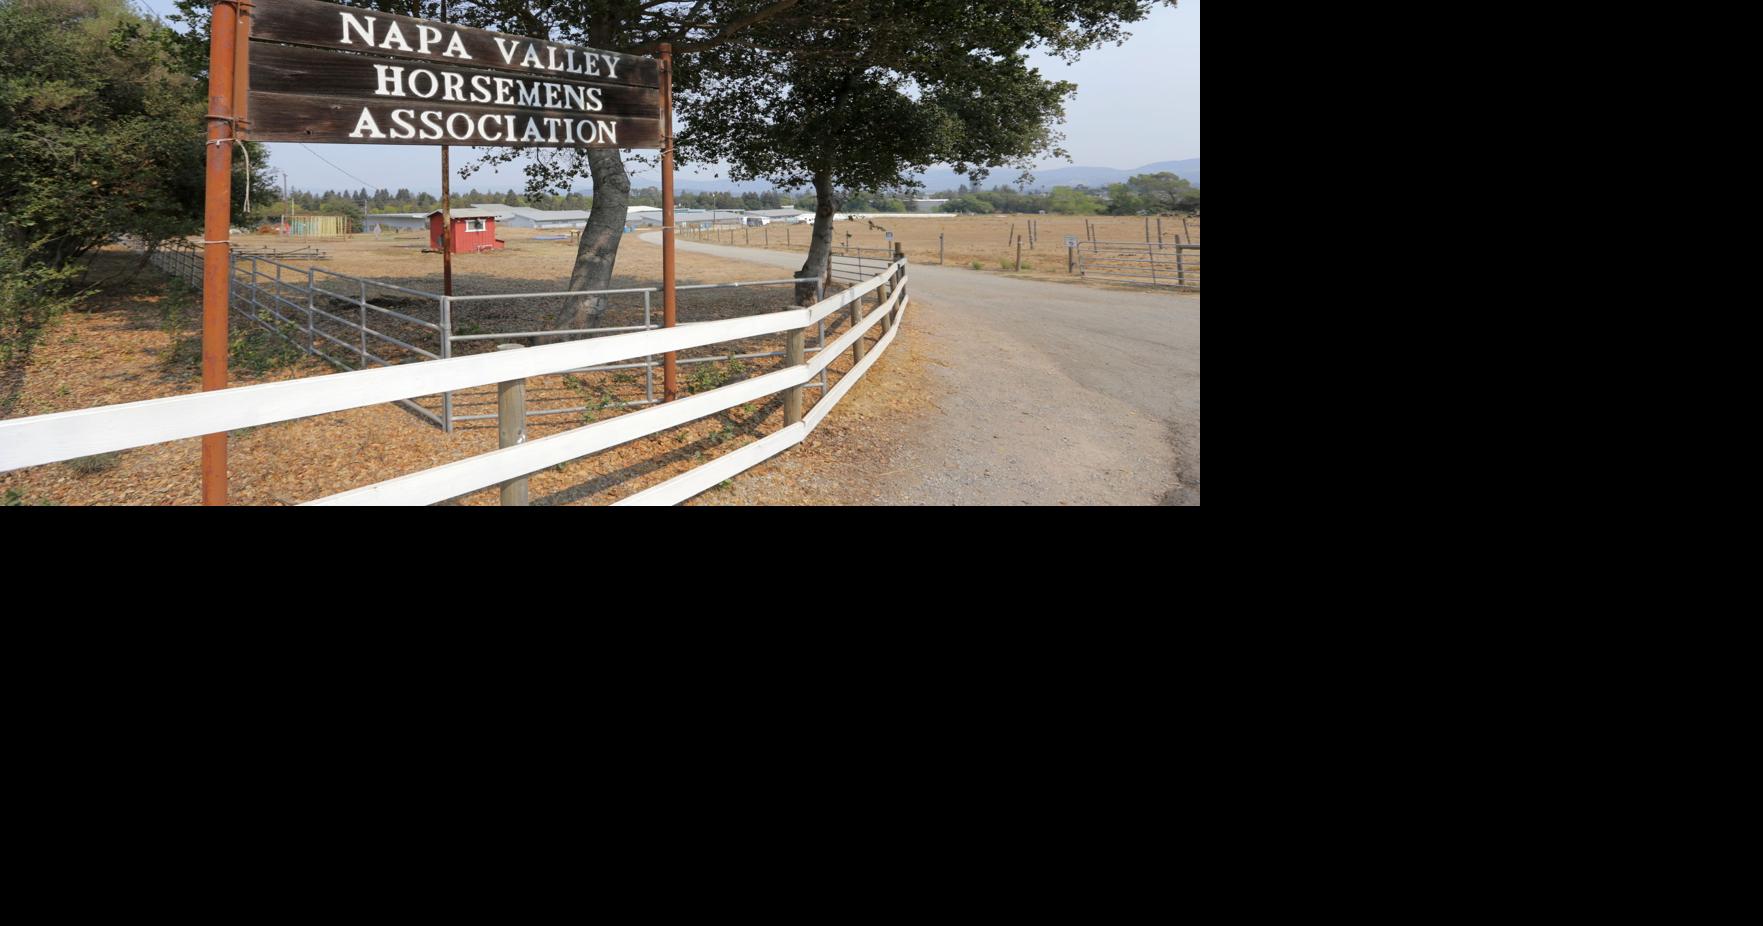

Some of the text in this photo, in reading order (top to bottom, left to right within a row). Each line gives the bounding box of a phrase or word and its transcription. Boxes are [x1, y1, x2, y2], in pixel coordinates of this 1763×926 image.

[339, 12, 620, 79] NAPA VALLEY
[373, 64, 603, 112] HORSEMENS
[349, 107, 618, 145] ASSOCIATION
